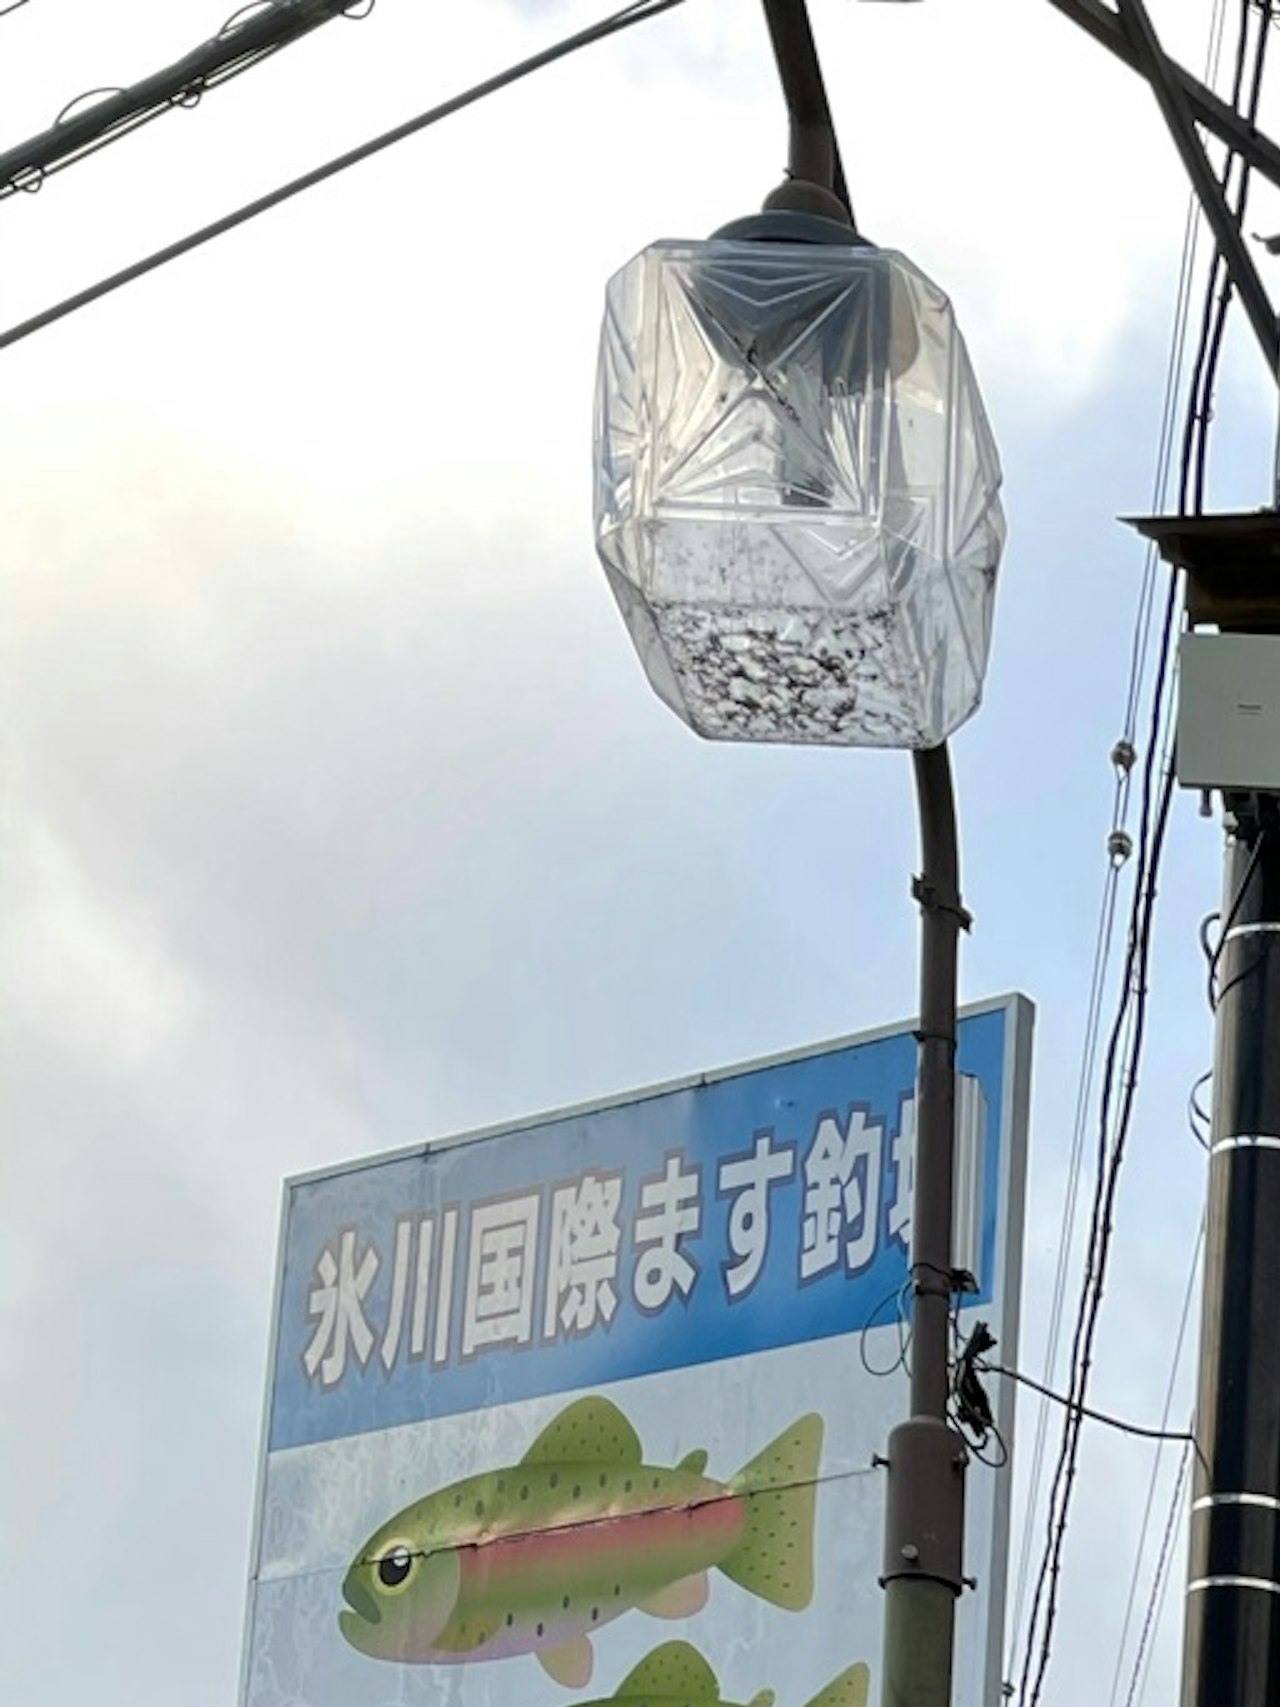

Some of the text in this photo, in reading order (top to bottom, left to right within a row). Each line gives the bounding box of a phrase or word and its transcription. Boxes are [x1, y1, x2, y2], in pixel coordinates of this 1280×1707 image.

[302, 1098, 914, 1386] 氷川国際ます釣
